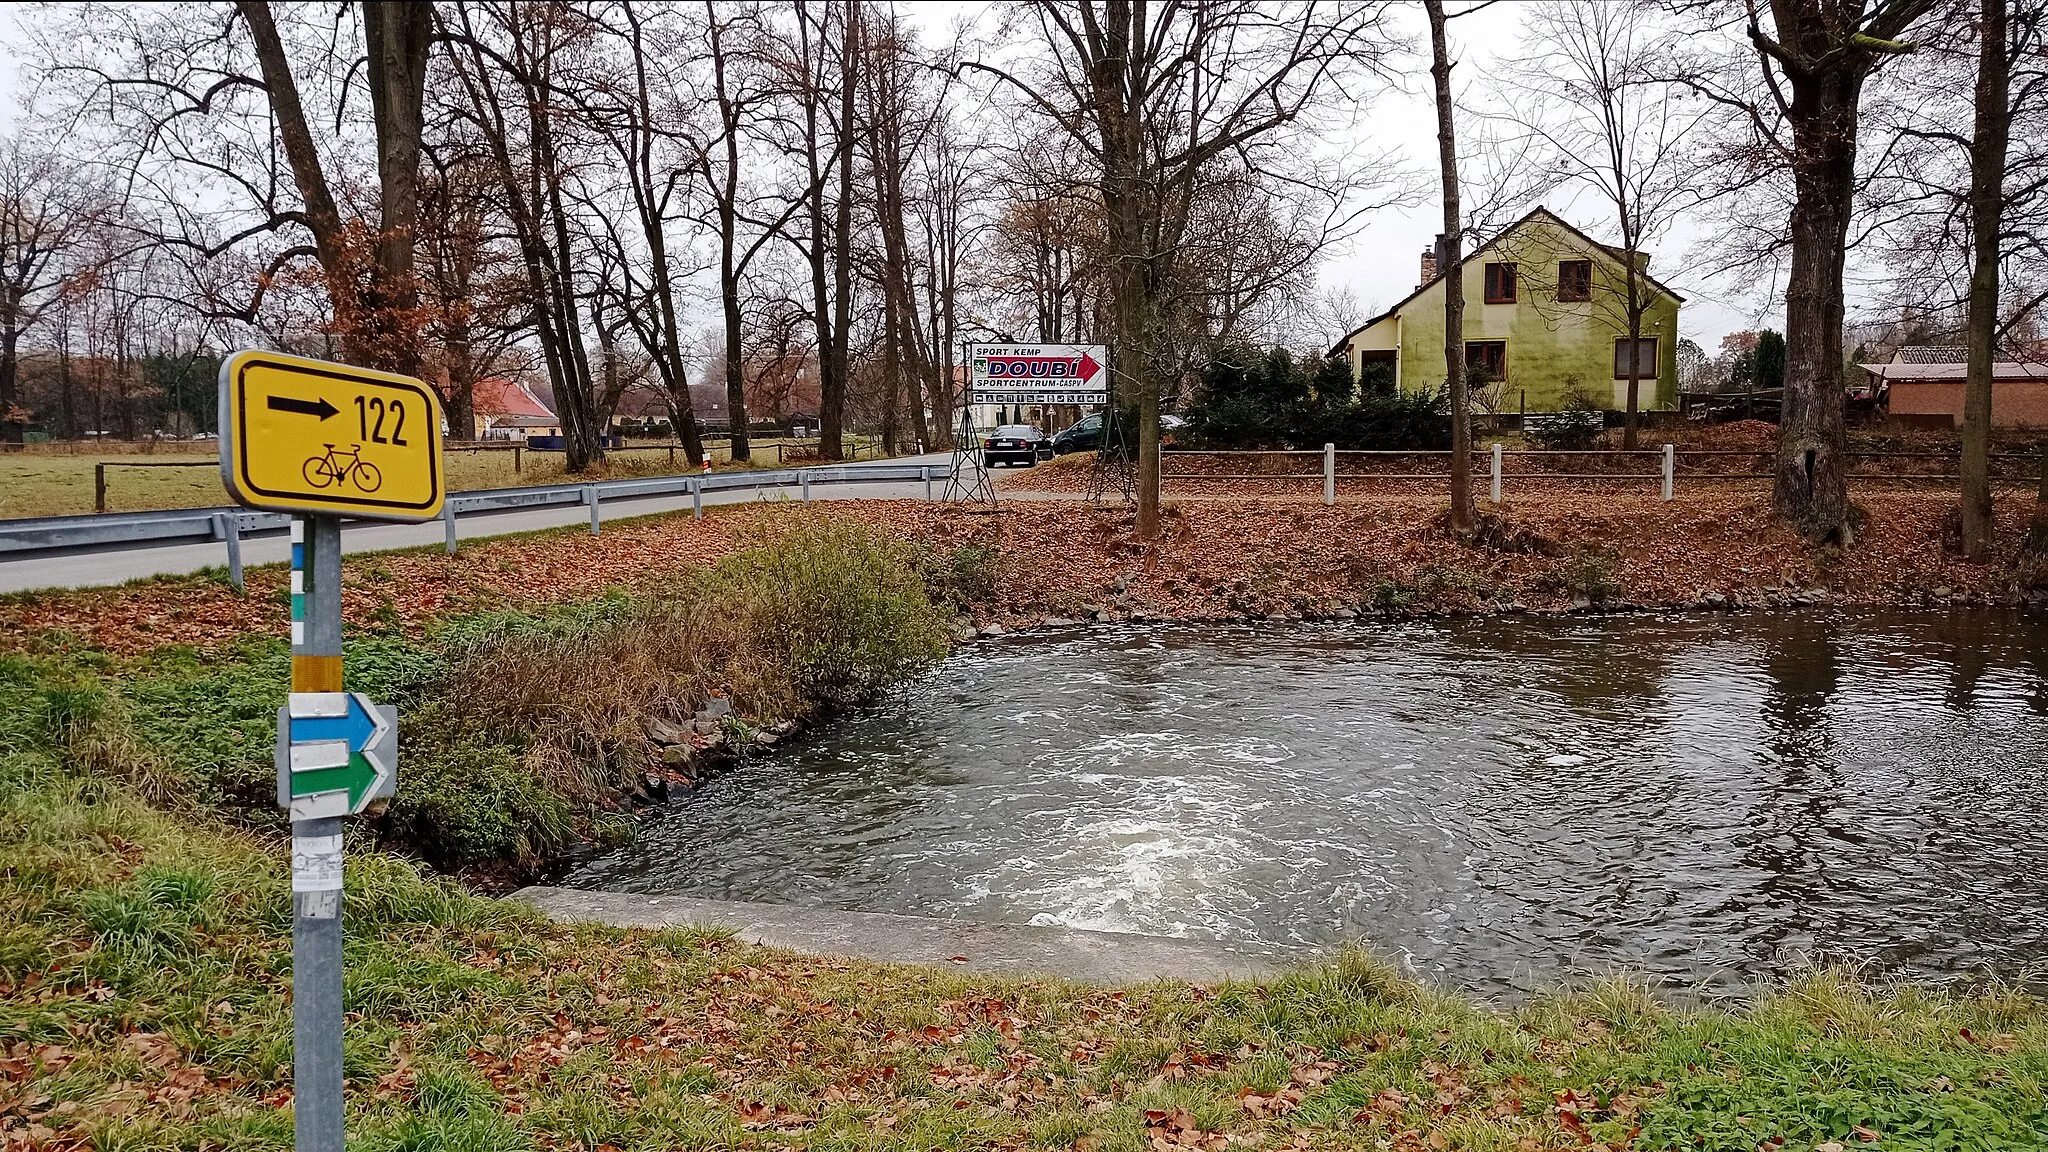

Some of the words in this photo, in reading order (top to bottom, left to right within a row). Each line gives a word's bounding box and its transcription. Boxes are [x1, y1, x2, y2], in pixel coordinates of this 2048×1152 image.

[976, 348, 1009, 356] SPORT
[988, 359, 1079, 377] DOUBÍ
[354, 395, 407, 447] 122
